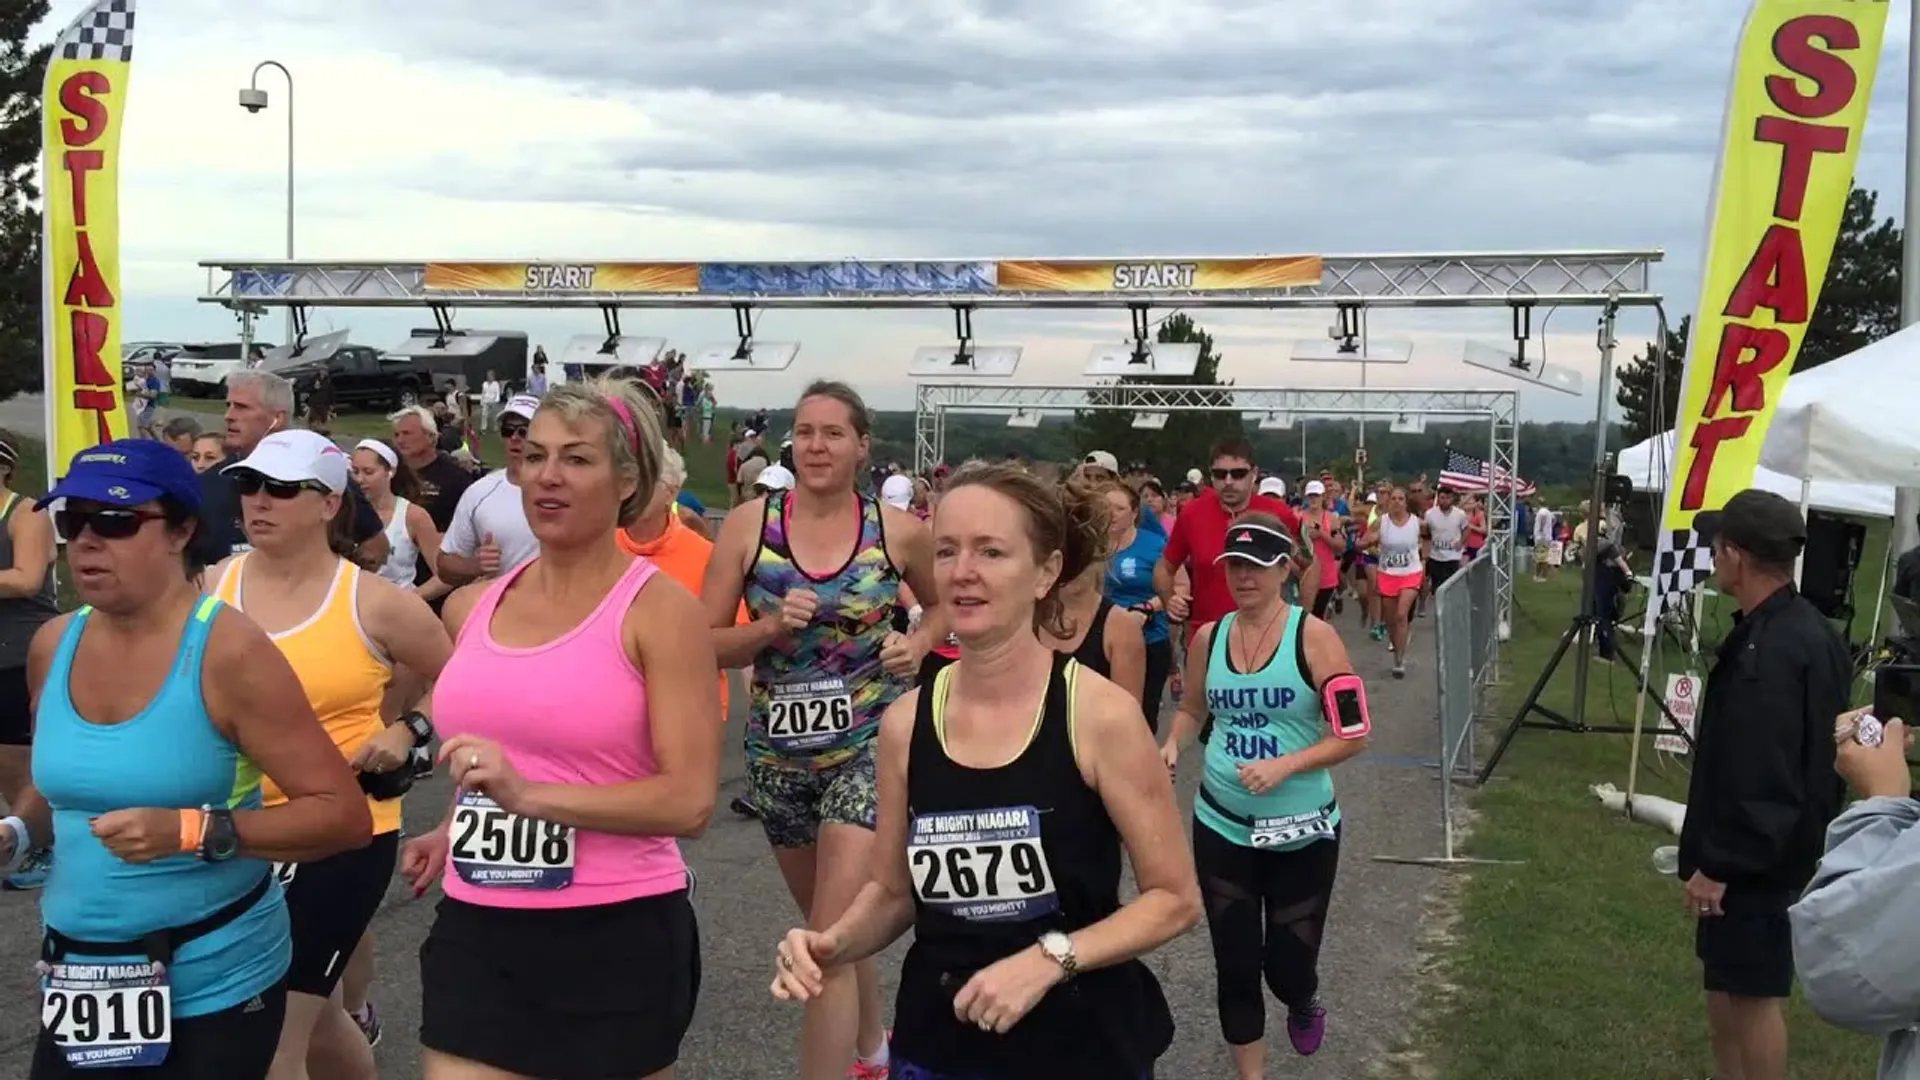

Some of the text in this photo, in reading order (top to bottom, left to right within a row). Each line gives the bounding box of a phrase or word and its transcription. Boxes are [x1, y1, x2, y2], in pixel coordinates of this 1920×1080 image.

[59, 70, 116, 446] START
[1679, 14, 1861, 512] START
[525, 264, 596, 289] START
[1113, 263, 1198, 289] START
[1207, 687, 1296, 709] SHUT UP
[771, 697, 850, 735] 2026
[1230, 712, 1269, 729] AND
[917, 815, 933, 834] THE
[935, 815, 975, 833] MIGHTY
[976, 810, 1030, 830] NIAGARA
[452, 809, 569, 865] 2508
[471, 869, 544, 879] ARE YOU MIGHTY?
[913, 843, 1046, 900] 2679
[970, 904, 988, 915] YOU
[988, 901, 1026, 912] MIGHTY?
[51, 965, 67, 978] THE
[67, 965, 107, 980] MIGHTY
[47, 990, 165, 1043] 2910
[85, 1050, 103, 1060] YOU
[103, 1045, 142, 1058] MIGHTY?
